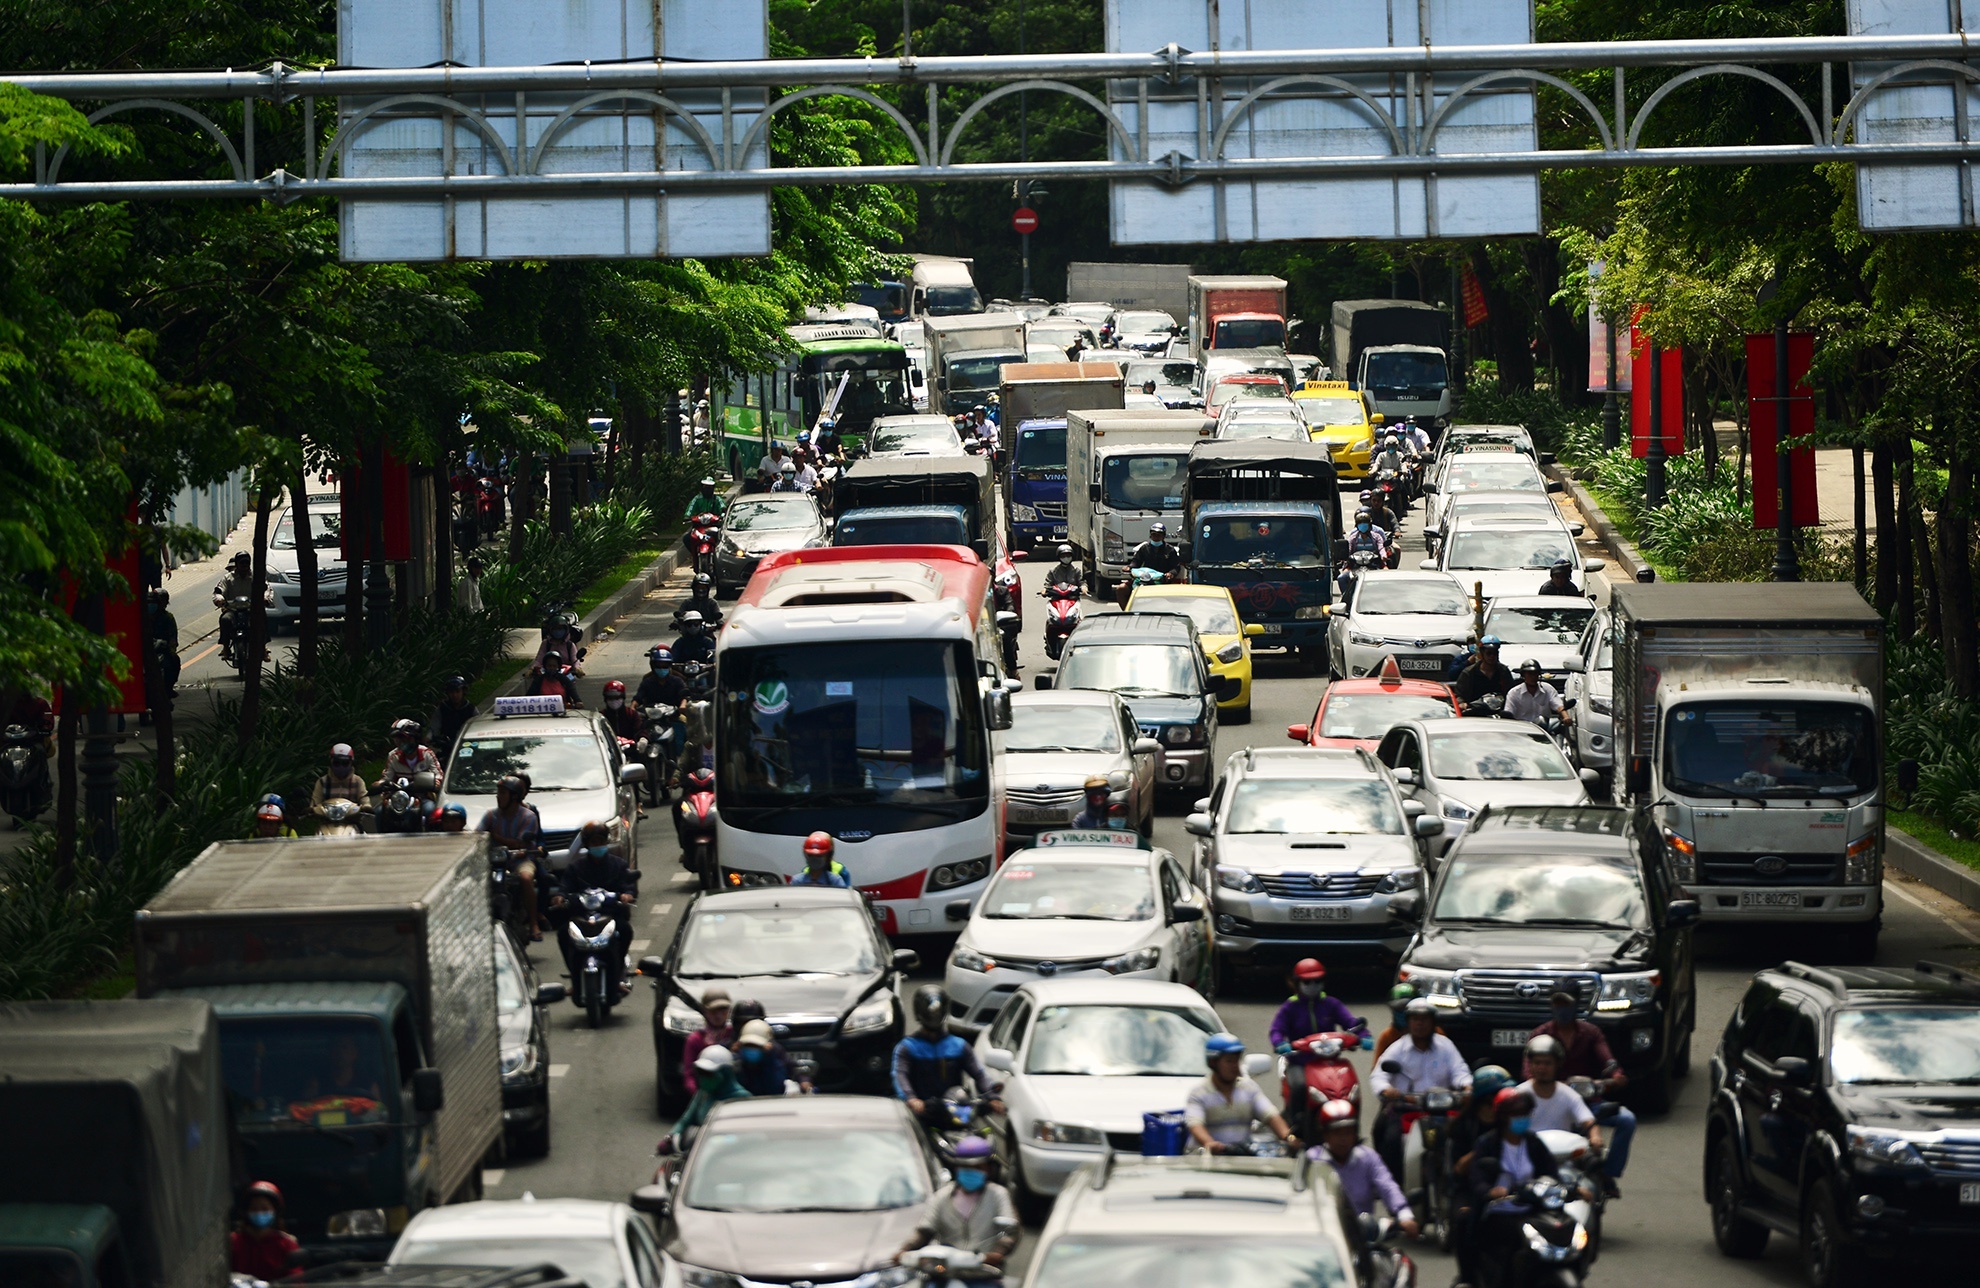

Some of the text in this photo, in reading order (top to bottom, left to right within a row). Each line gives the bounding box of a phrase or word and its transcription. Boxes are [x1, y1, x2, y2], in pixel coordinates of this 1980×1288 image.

[501, 703, 556, 714] 38 118 118
[839, 830, 871, 838] SAMCO
[1961, 1184, 1979, 1201] 51
